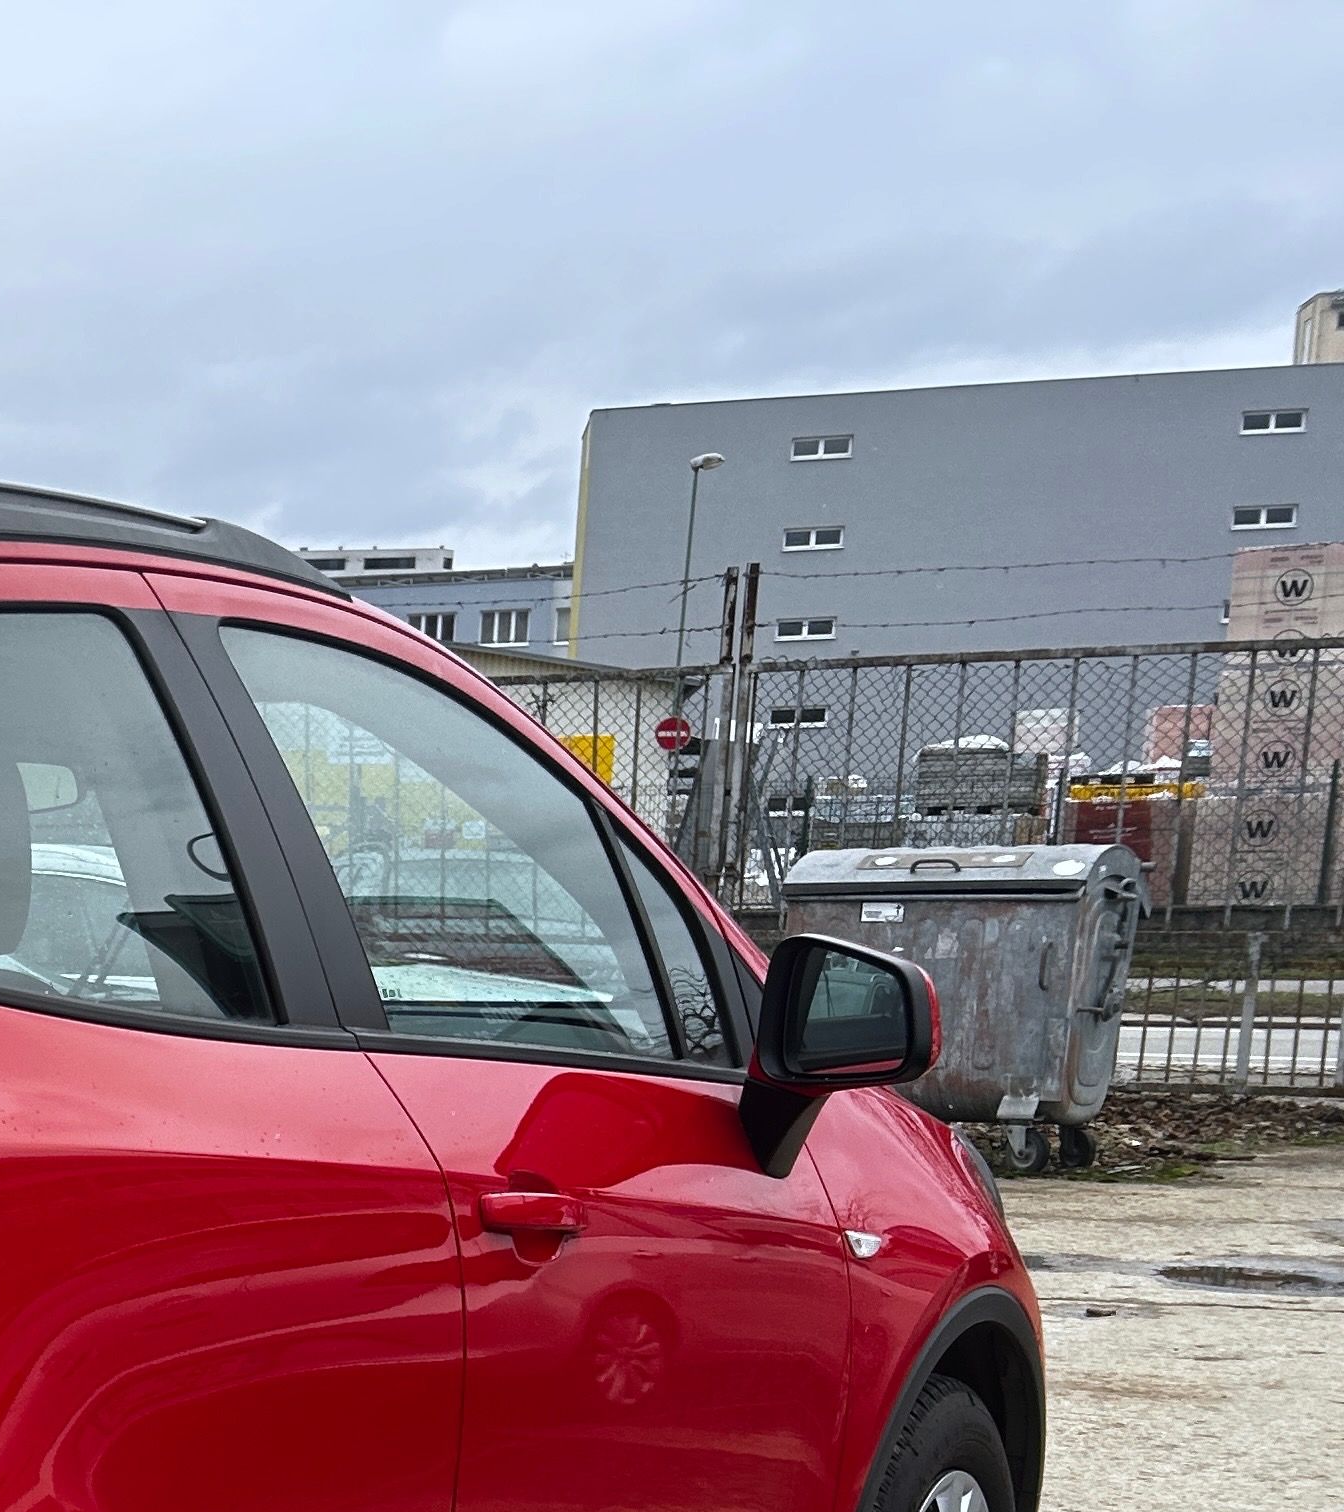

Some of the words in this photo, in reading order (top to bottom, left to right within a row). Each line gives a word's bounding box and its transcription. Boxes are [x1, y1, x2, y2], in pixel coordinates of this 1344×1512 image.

[1280, 579, 1309, 598] W
[1270, 690, 1298, 708] W
[1262, 751, 1291, 768] W
[1246, 820, 1274, 838] W
[1238, 880, 1269, 898] W
